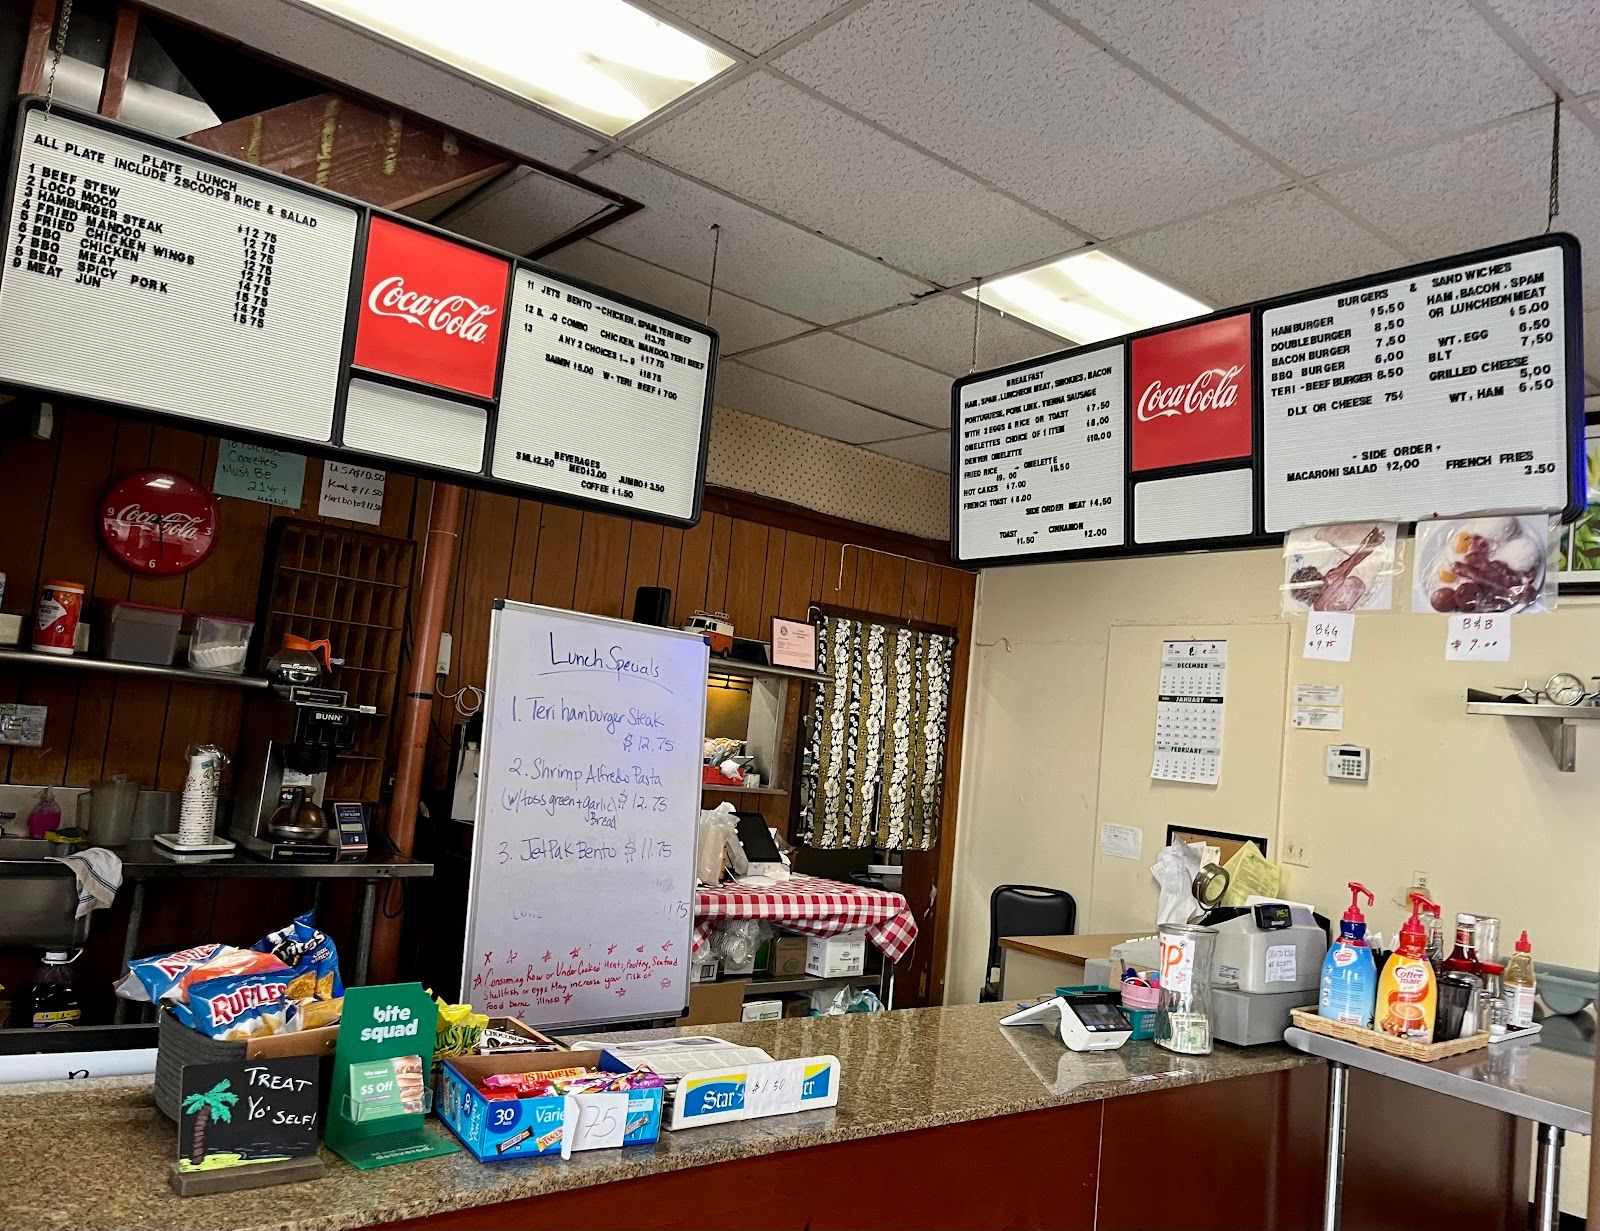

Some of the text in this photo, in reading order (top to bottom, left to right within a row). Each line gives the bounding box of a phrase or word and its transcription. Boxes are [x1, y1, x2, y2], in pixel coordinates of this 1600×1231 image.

[34, 134, 317, 227] ALL PLATE INCLUDE RICE SALAD
[42, 167, 120, 197] BEEF STEW
[142, 154, 237, 192] PLATE LUNCH
[40, 178, 117, 208] LOCO MOCO
[24, 186, 163, 234] 3 HAMBURGER STEAK
[36, 202, 141, 239] FRIED MANDOO
[32, 225, 139, 262] BBQ CHICKEN
[35, 213, 194, 265] FRIED CHICKEN WINGS
[30, 237, 115, 267] BBQ MEAT
[27, 260, 101, 288] MEAT JUN
[29, 249, 167, 293] BBQ SPICY PORK
[542, 286, 592, 309] JETS BENTO
[1338, 289, 1388, 308] BURGERS
[368, 276, 496, 342] Coca-Cola
[1429, 307, 1444, 318] OR
[1272, 317, 1333, 337] HAMBURGER
[1464, 330, 1488, 342] EGG
[558, 334, 617, 359] ANY CHOICES
[562, 317, 704, 370] COMBO BEEF
[1272, 345, 1452, 366] BACON BURGER BLT
[1007, 371, 1044, 387] BREAKFAST
[1088, 367, 1111, 379] BACON
[1272, 356, 1528, 381] BBQ BURGER GRILLED CHEESE
[616, 375, 656, 393] TERI BEEF
[1137, 364, 1245, 421] Coca-Cola
[1271, 373, 1372, 396] TERI BURGER
[1006, 388, 1096, 415] PORK VIENNA SAUSAGE
[1288, 386, 1504, 416] DLX OR CHEESE HAM
[965, 410, 1068, 438] WITH EGGS RICE OR TOAST
[965, 425, 1065, 451] OMELETTES CHOICE OF ITEM
[554, 451, 600, 469] BEVERAGES
[965, 448, 1022, 465] DENVER OMELETTE
[1362, 444, 1432, 460] SIDE ORDER
[222, 464, 272, 479] Must Be
[964, 456, 1057, 479] FRIED RICE OMELETTE
[1287, 451, 1533, 482] MACARONI SALAD FRENCH FRIES
[581, 480, 609, 493] COFFEE
[978, 485, 998, 494] CAKES
[108, 507, 114, 516] 9
[964, 497, 1007, 509] FRENCH TOAST
[1026, 501, 1086, 515] SIDE ORDER MEAT
[205, 527, 211, 536] 3
[1000, 522, 1083, 538] TOAST CINNAMON
[149, 559, 155, 568] 6
[550, 632, 602, 668] Lunch
[316, 713, 341, 721] BUNN
[526, 696, 555, 720] Teri
[561, 698, 625, 734] hamburger
[627, 707, 664, 727] Steak
[531, 760, 583, 791] Shrimp
[585, 764, 630, 784] Alfredo
[634, 765, 663, 787] Pasta
[590, 812, 616, 830] Bread
[576, 843, 617, 860] Bento
[546, 971, 554, 979] or
[1395, 967, 1423, 979] Coffee
[532, 986, 548, 996] eggs
[570, 978, 601, 989] increase
[604, 976, 621, 989] your
[210, 982, 287, 1028] RUFFLES
[536, 994, 561, 1006] illness
[373, 1004, 411, 1023] bite
[360, 1019, 418, 1043] squad
[244, 1067, 313, 1092] TREAT
[361, 1081, 394, 1096] $5 Off
[701, 1091, 735, 1113] Star
[272, 1110, 317, 1131] SELF!
[494, 1108, 515, 1126] 30
